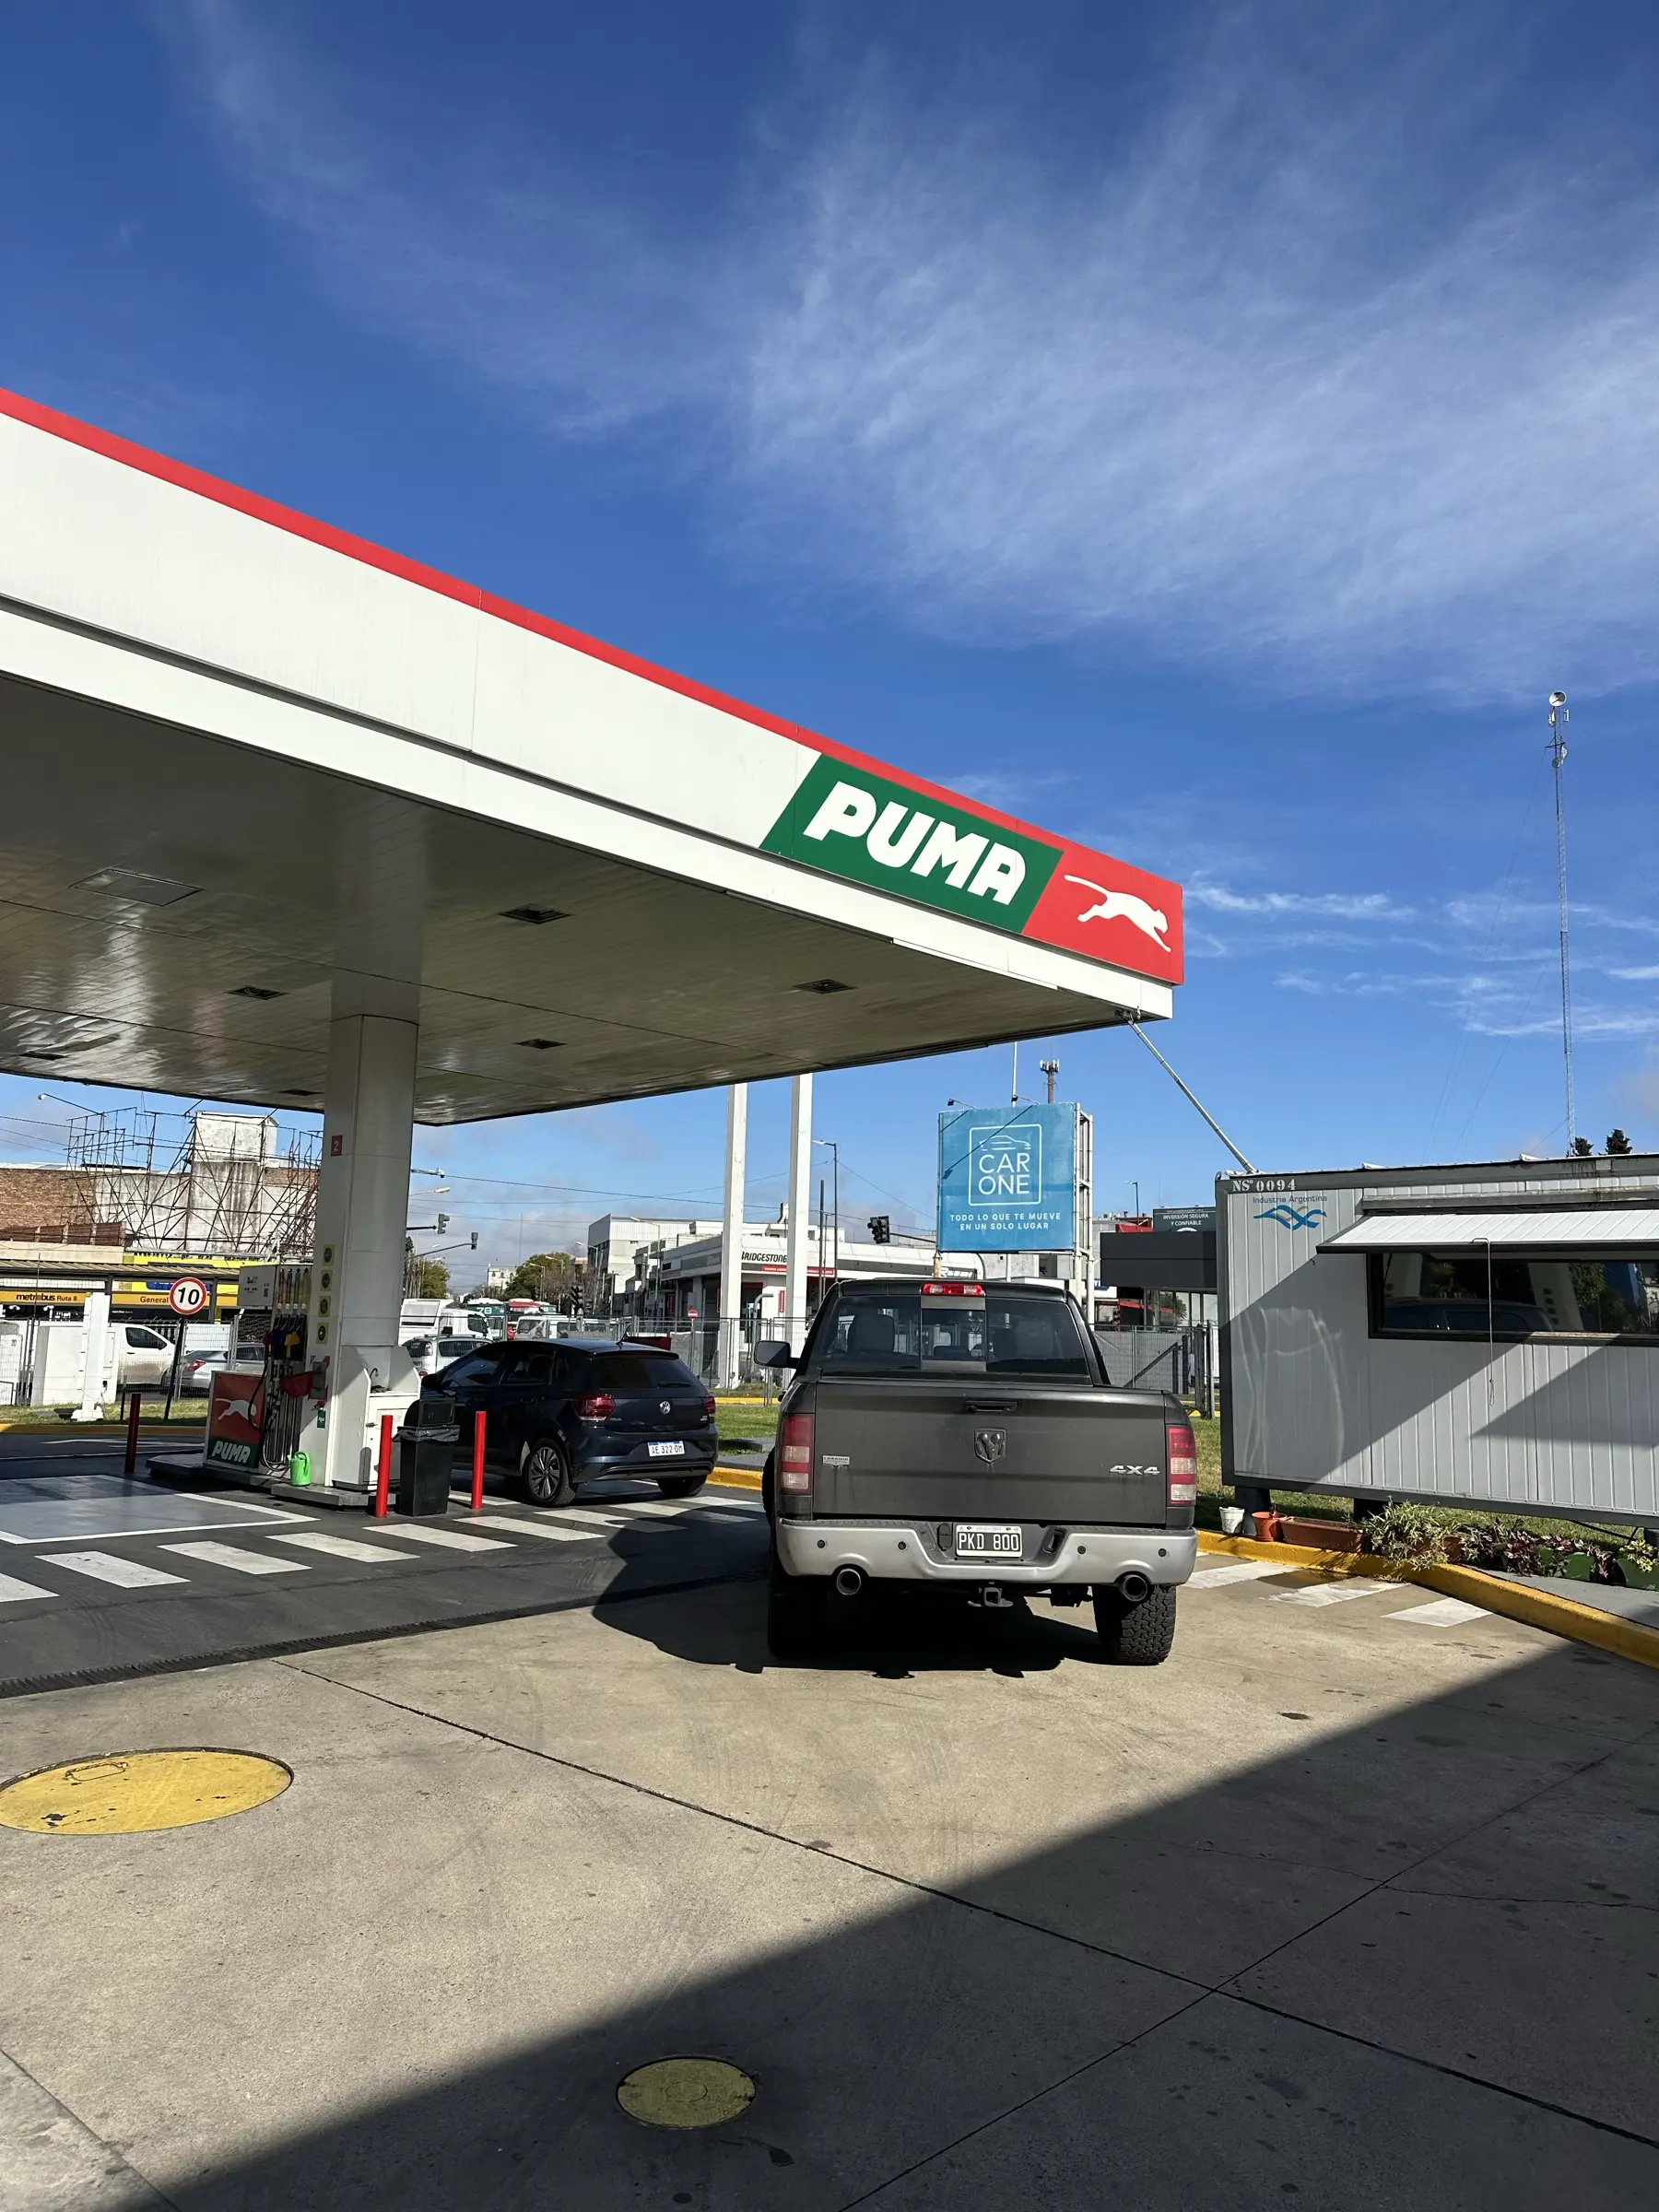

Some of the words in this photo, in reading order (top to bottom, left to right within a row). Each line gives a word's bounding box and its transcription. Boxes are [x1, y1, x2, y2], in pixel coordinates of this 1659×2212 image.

[803, 781, 1026, 905] PUMA
[334, 1139, 339, 1151] 2
[979, 1152, 1030, 1173] CAR
[978, 1174, 1030, 1194] ONE
[1256, 1179, 1297, 1192] 0094
[1253, 1195, 1287, 1204] Industria
[1288, 1194, 1328, 1204] Argentina
[992, 1213, 1010, 1221] QUE
[1029, 1212, 1061, 1220] MUEVE
[139, 1295, 169, 1303] General
[178, 1287, 200, 1305] 10
[476, 1306, 492, 1314] 78
[212, 1441, 251, 1464] PUMA
[651, 1446, 660, 1454] AE
[661, 1445, 673, 1453] 322
[1109, 1465, 1160, 1476] 4X4
[959, 1533, 984, 1550] PKD
[993, 1534, 1019, 1551] 800
